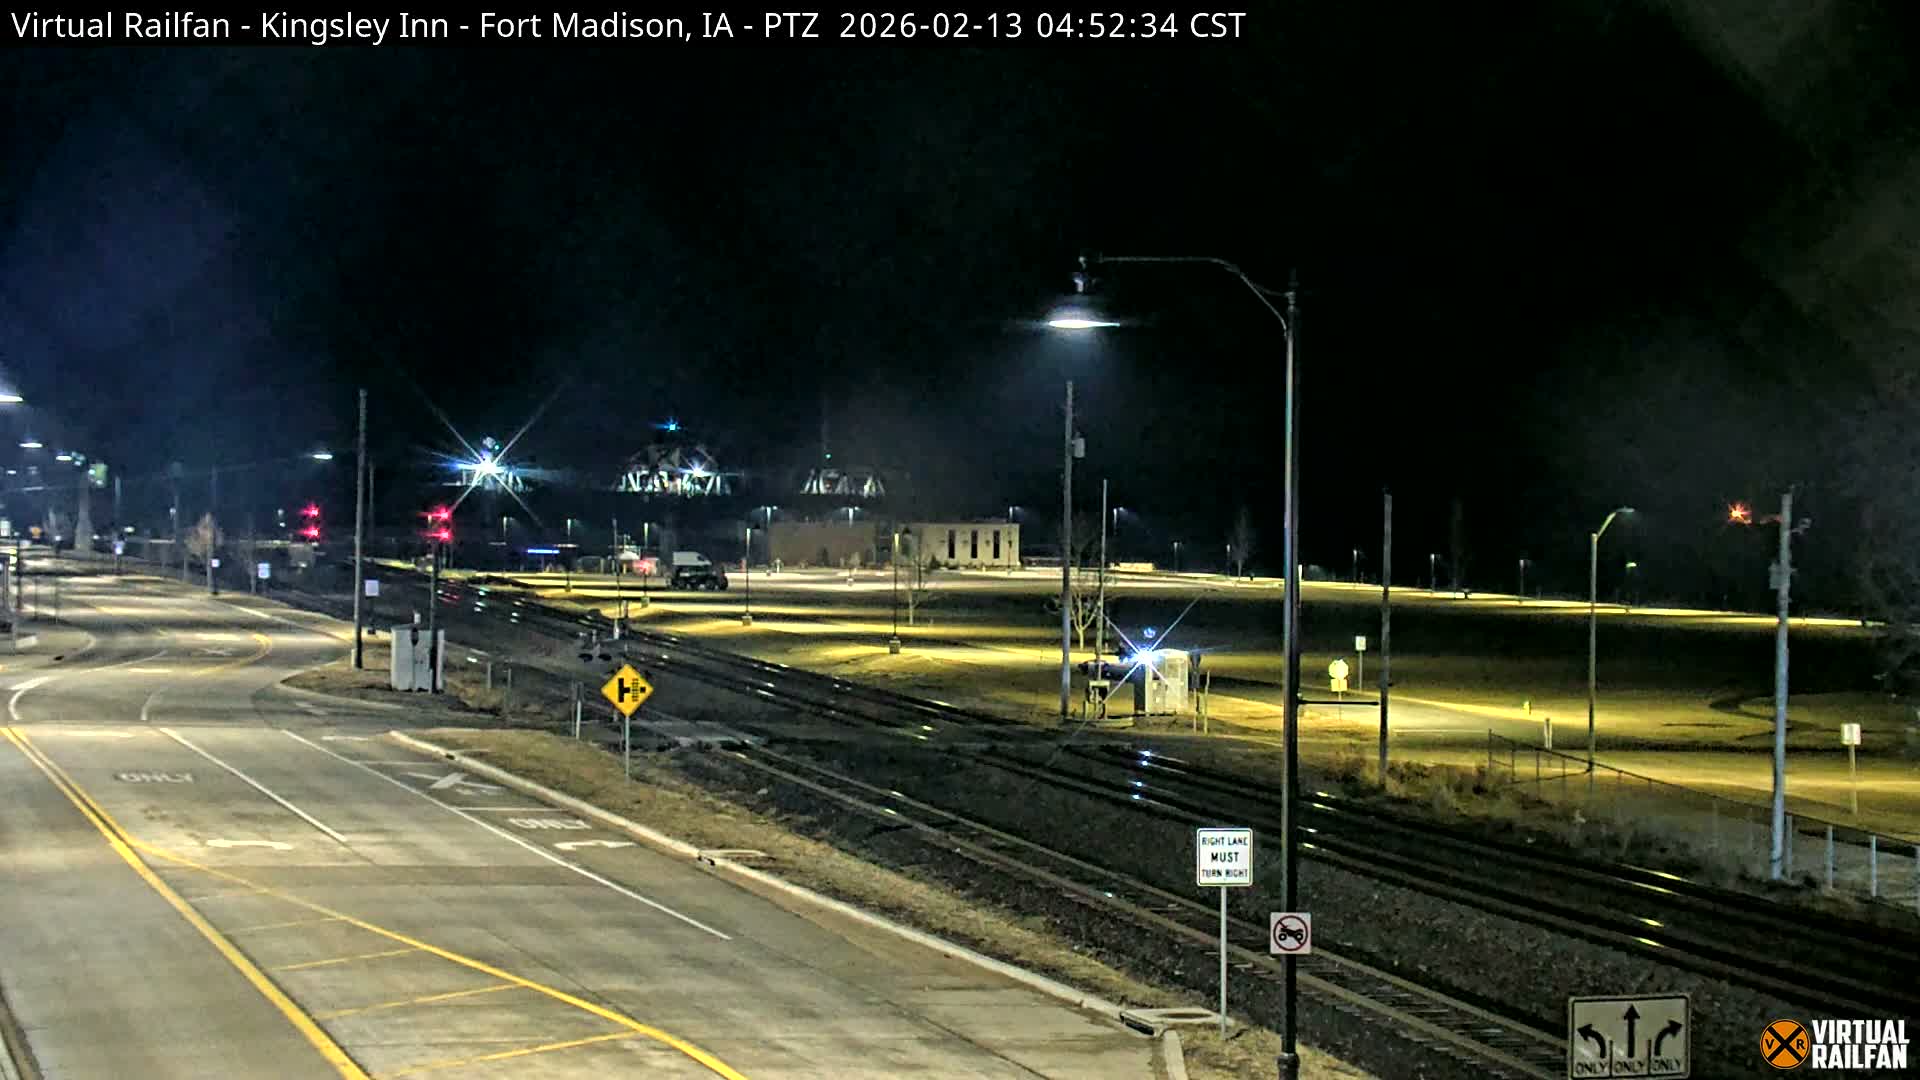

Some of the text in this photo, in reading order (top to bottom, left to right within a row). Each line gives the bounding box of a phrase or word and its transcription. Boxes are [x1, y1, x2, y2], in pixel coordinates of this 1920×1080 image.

[1202, 836, 1249, 846] RIGHT LANE
[1211, 852, 1239, 863] MUST
[1201, 869, 1248, 878] TURN RIGHT
[1575, 1062, 1608, 1075] ONLY
[1615, 1060, 1645, 1074] ONLY
